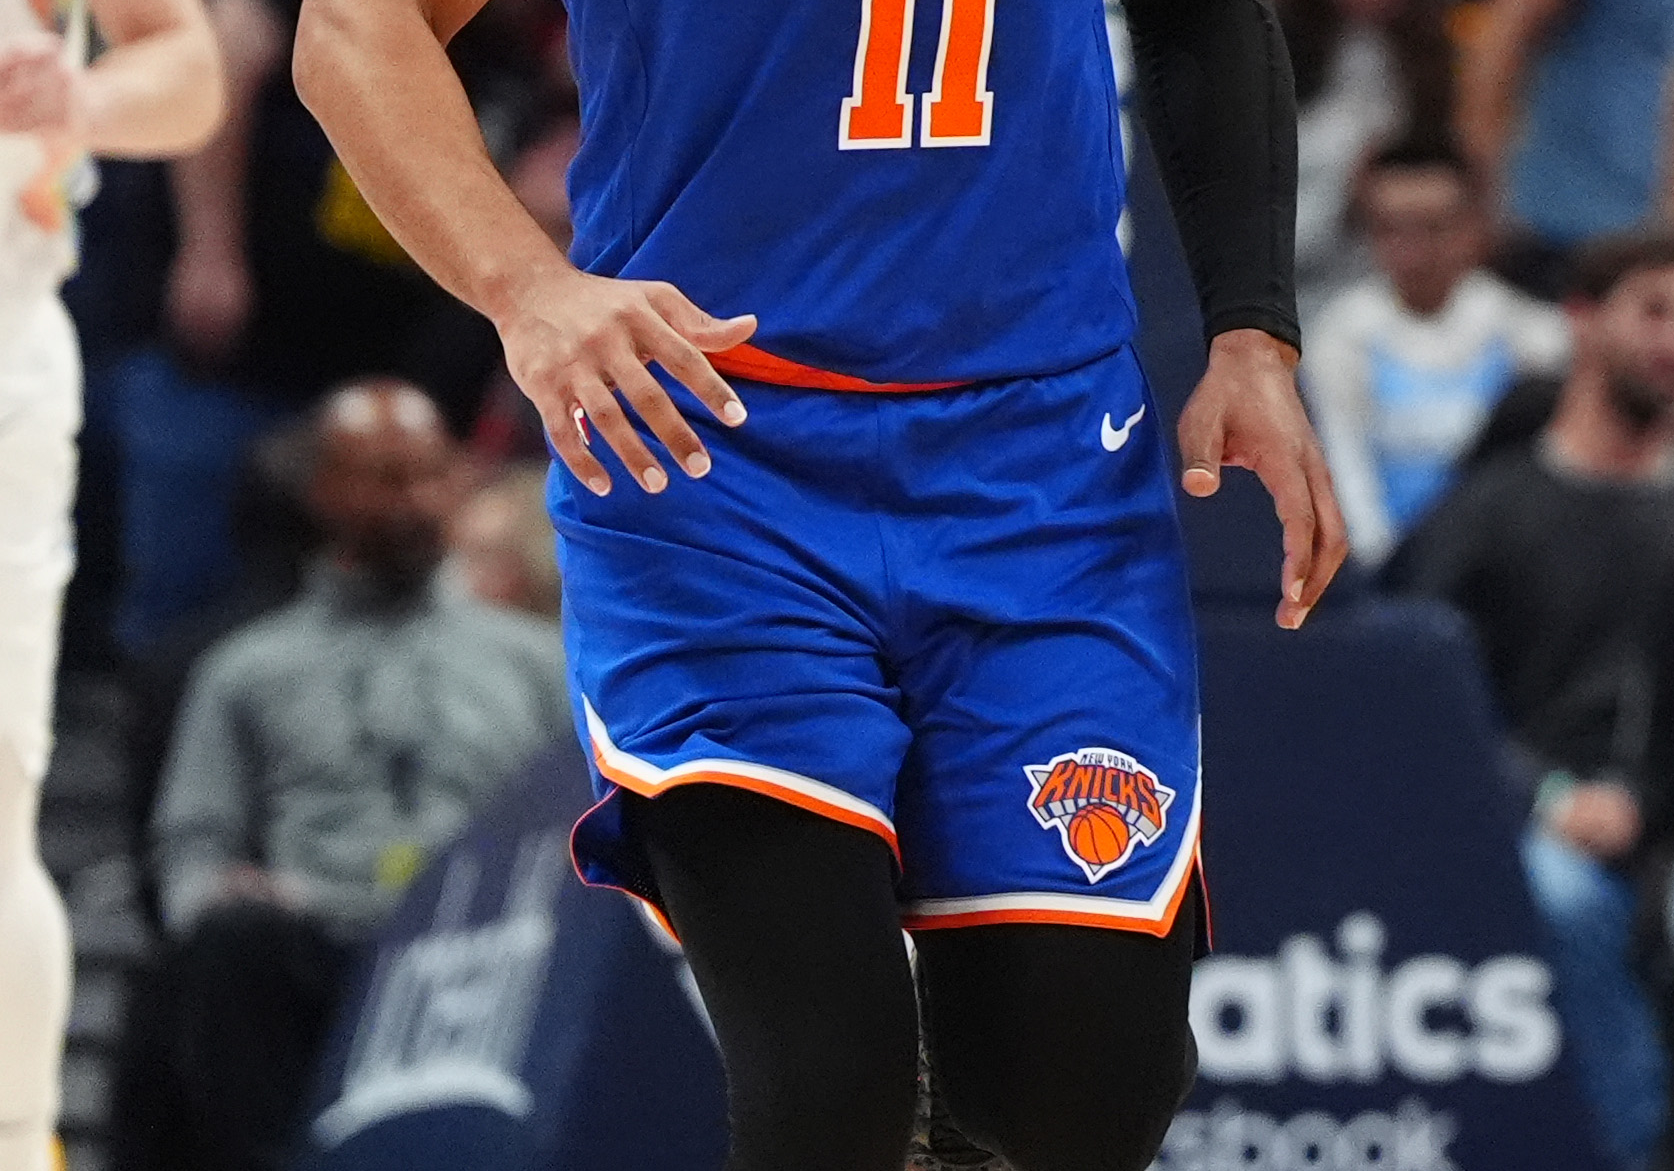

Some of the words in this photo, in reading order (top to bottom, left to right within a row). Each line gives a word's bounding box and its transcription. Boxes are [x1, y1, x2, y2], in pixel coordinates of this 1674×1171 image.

[1033, 758, 1162, 830] KNICKS
[1080, 752, 1104, 764] NEW
[1107, 753, 1134, 773] YORK
[1188, 912, 1562, 1083] atics
[1145, 1098, 1458, 1171] sbook
